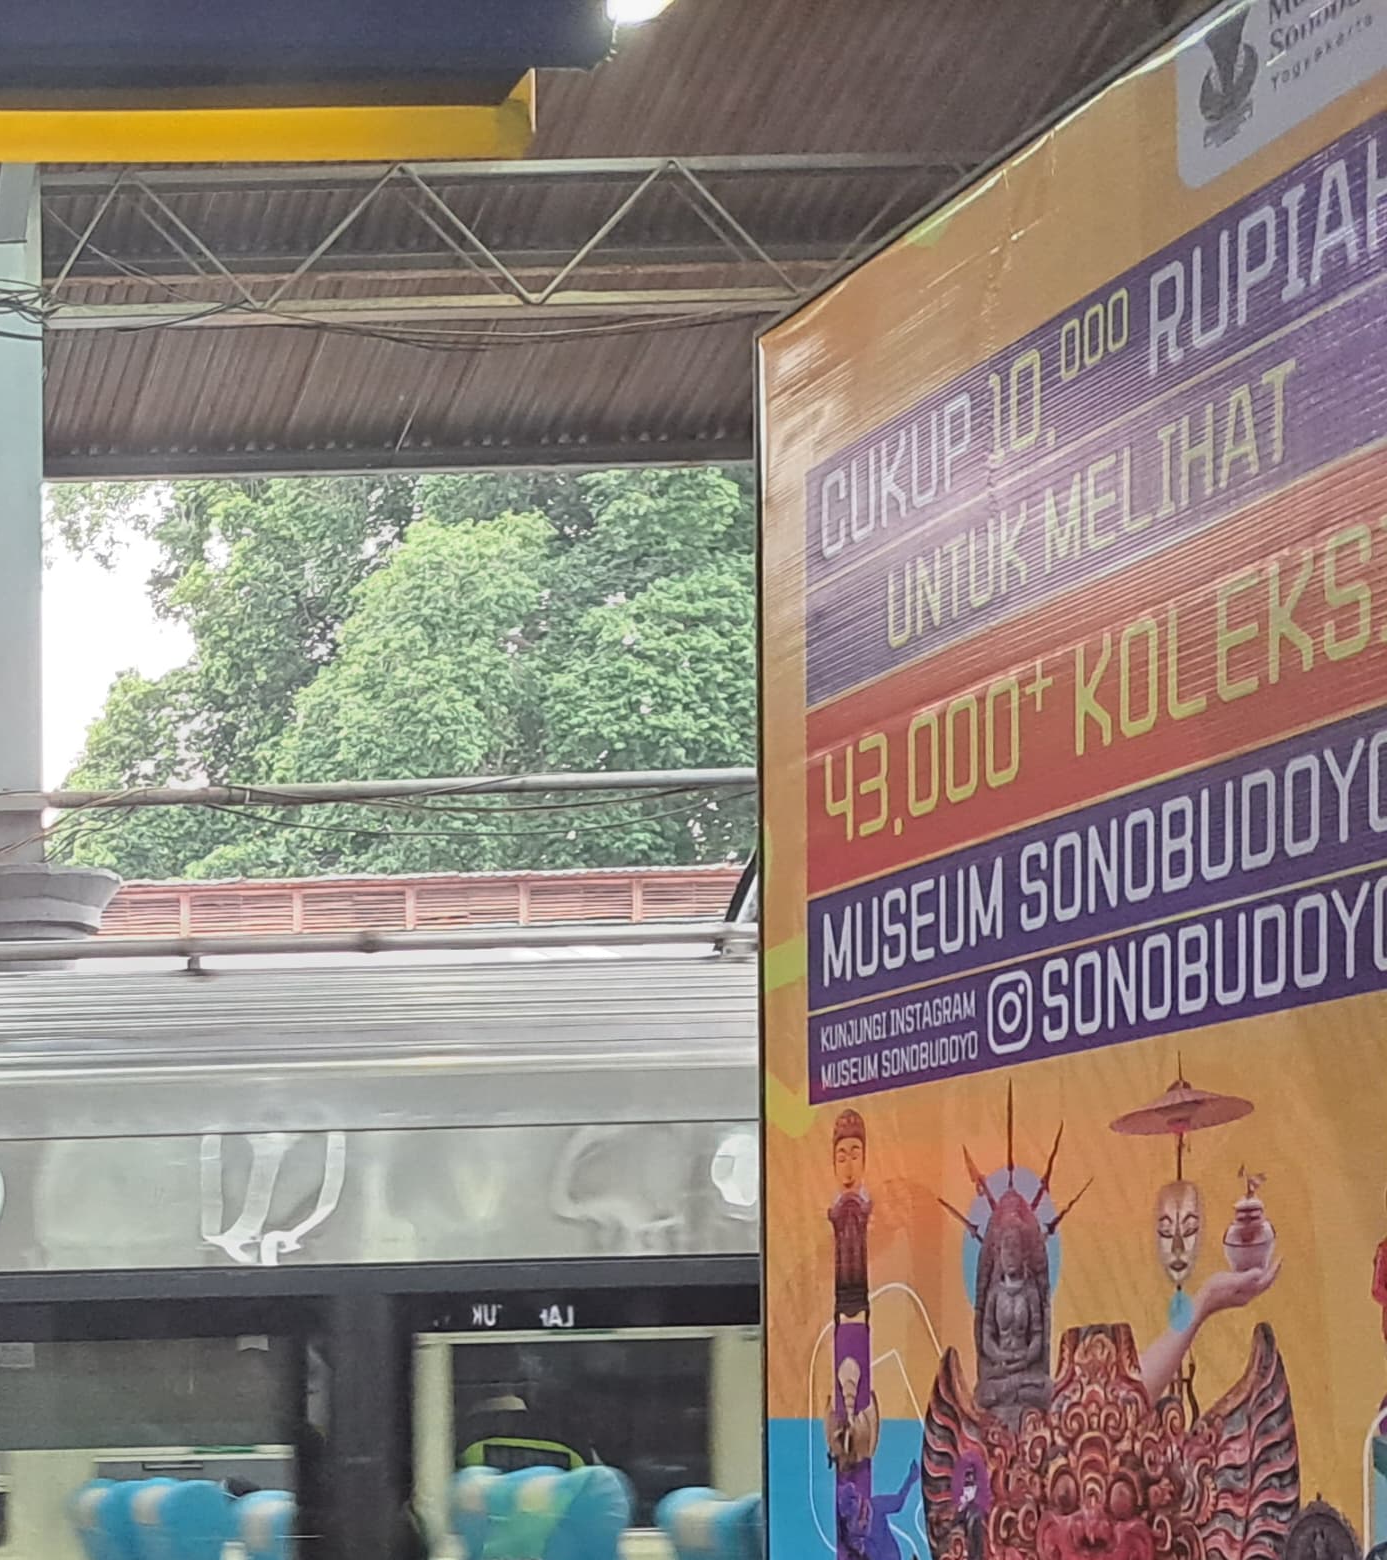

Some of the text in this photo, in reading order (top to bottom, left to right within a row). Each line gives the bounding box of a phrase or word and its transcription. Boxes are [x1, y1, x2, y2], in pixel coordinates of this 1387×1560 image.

[822, 391, 971, 559] CUKUP
[888, 359, 1296, 648] UNTUK MELIHAT
[823, 856, 1003, 988] MUSEUM
[820, 989, 976, 1053] KUNJUNGI INSTAGRAM
[821, 1030, 978, 1091] MUSEUM SONOBUDOYO
